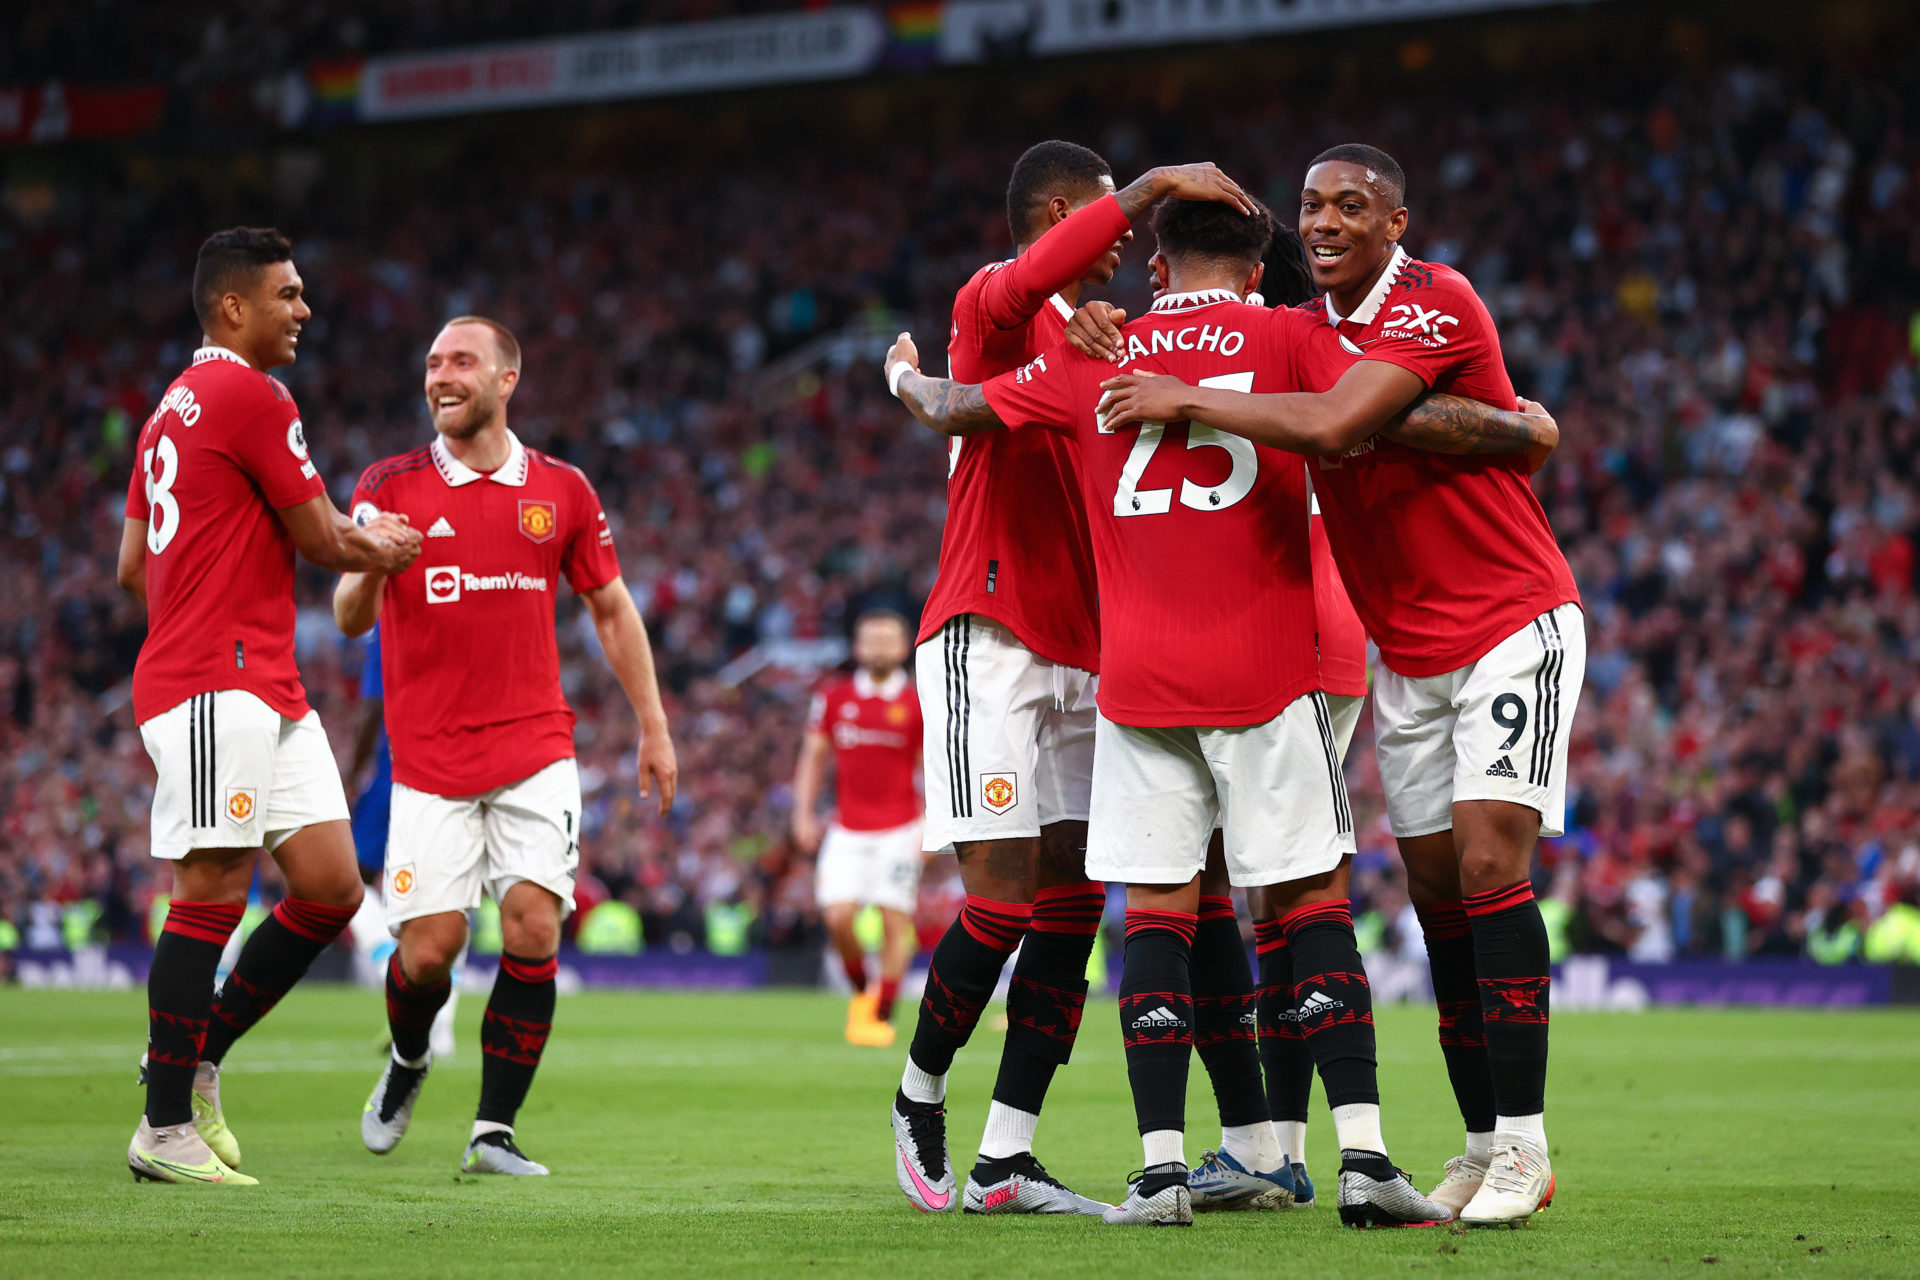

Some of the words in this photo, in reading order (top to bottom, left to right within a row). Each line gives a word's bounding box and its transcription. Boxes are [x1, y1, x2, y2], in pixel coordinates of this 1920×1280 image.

[1383, 303, 1460, 345] DXC
[1096, 371, 1258, 517] 25
[460, 571, 547, 592] TeamViewe
[1491, 692, 1527, 750] 9
[1485, 768, 1518, 778] adidas
[1297, 1000, 1345, 1022] adidas
[1131, 1018, 1187, 1029] adidas
